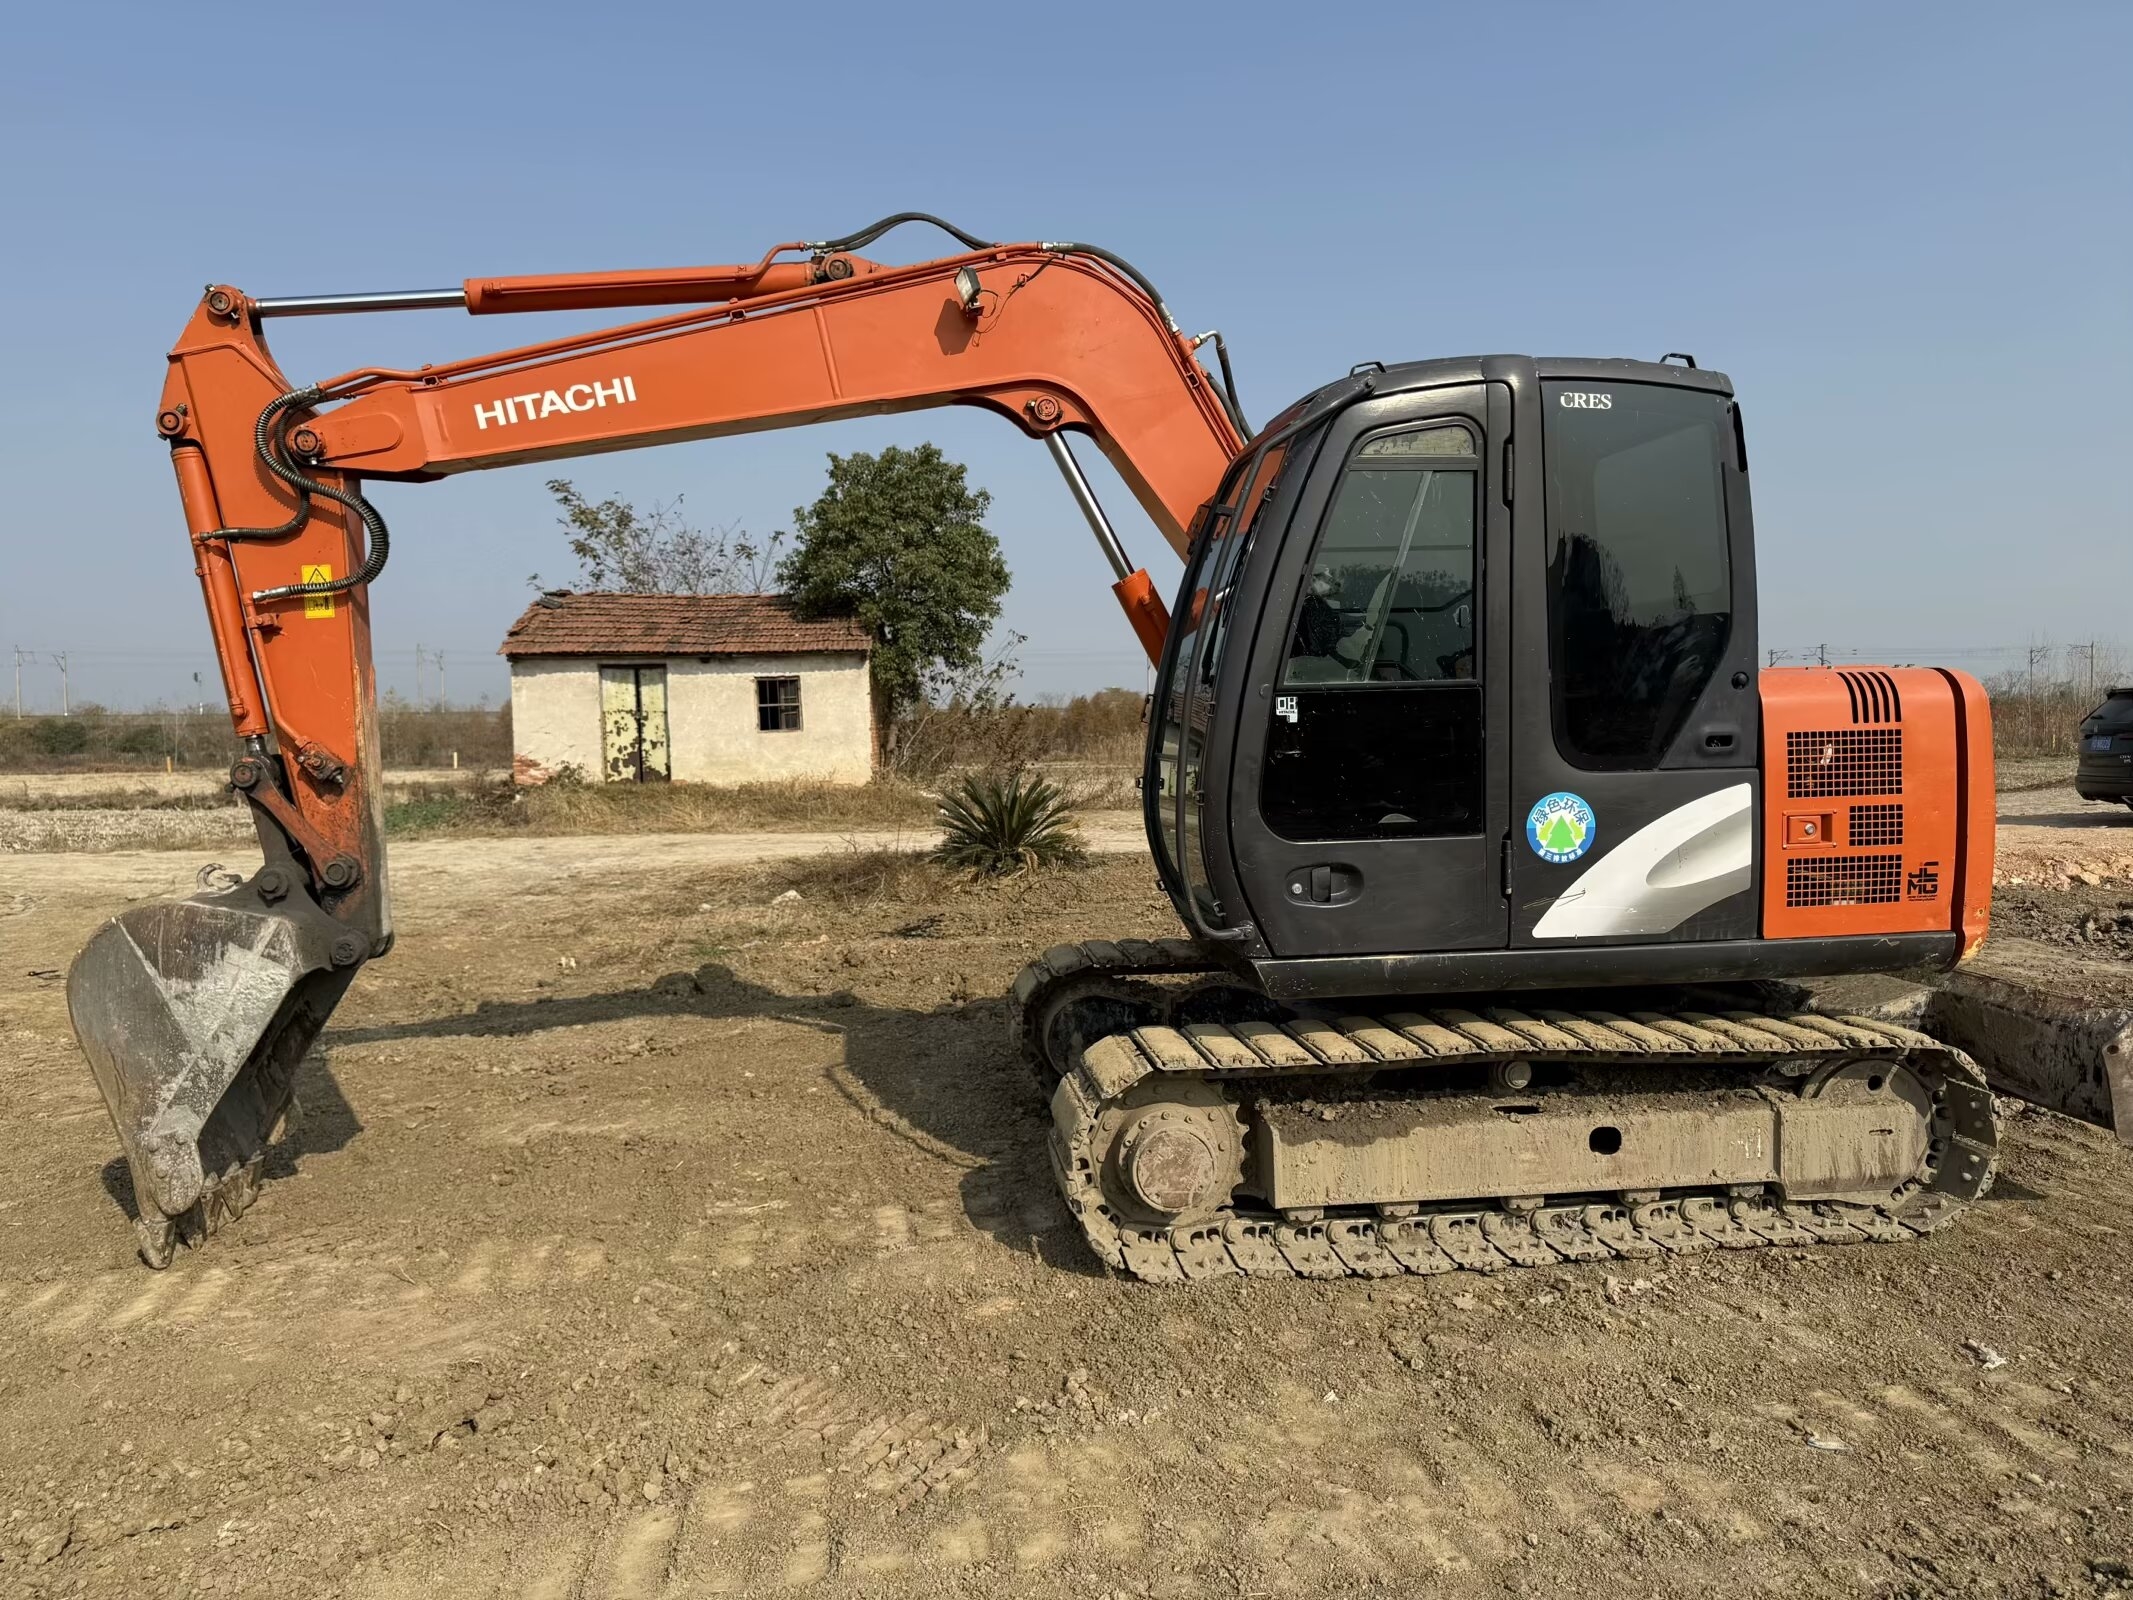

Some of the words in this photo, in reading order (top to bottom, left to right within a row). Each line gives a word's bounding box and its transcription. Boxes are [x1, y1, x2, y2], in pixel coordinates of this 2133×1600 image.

[474, 376, 637, 430] HITACHI
[1560, 392, 1612, 410] CRES
[1532, 797, 1590, 826] 绿色环保
